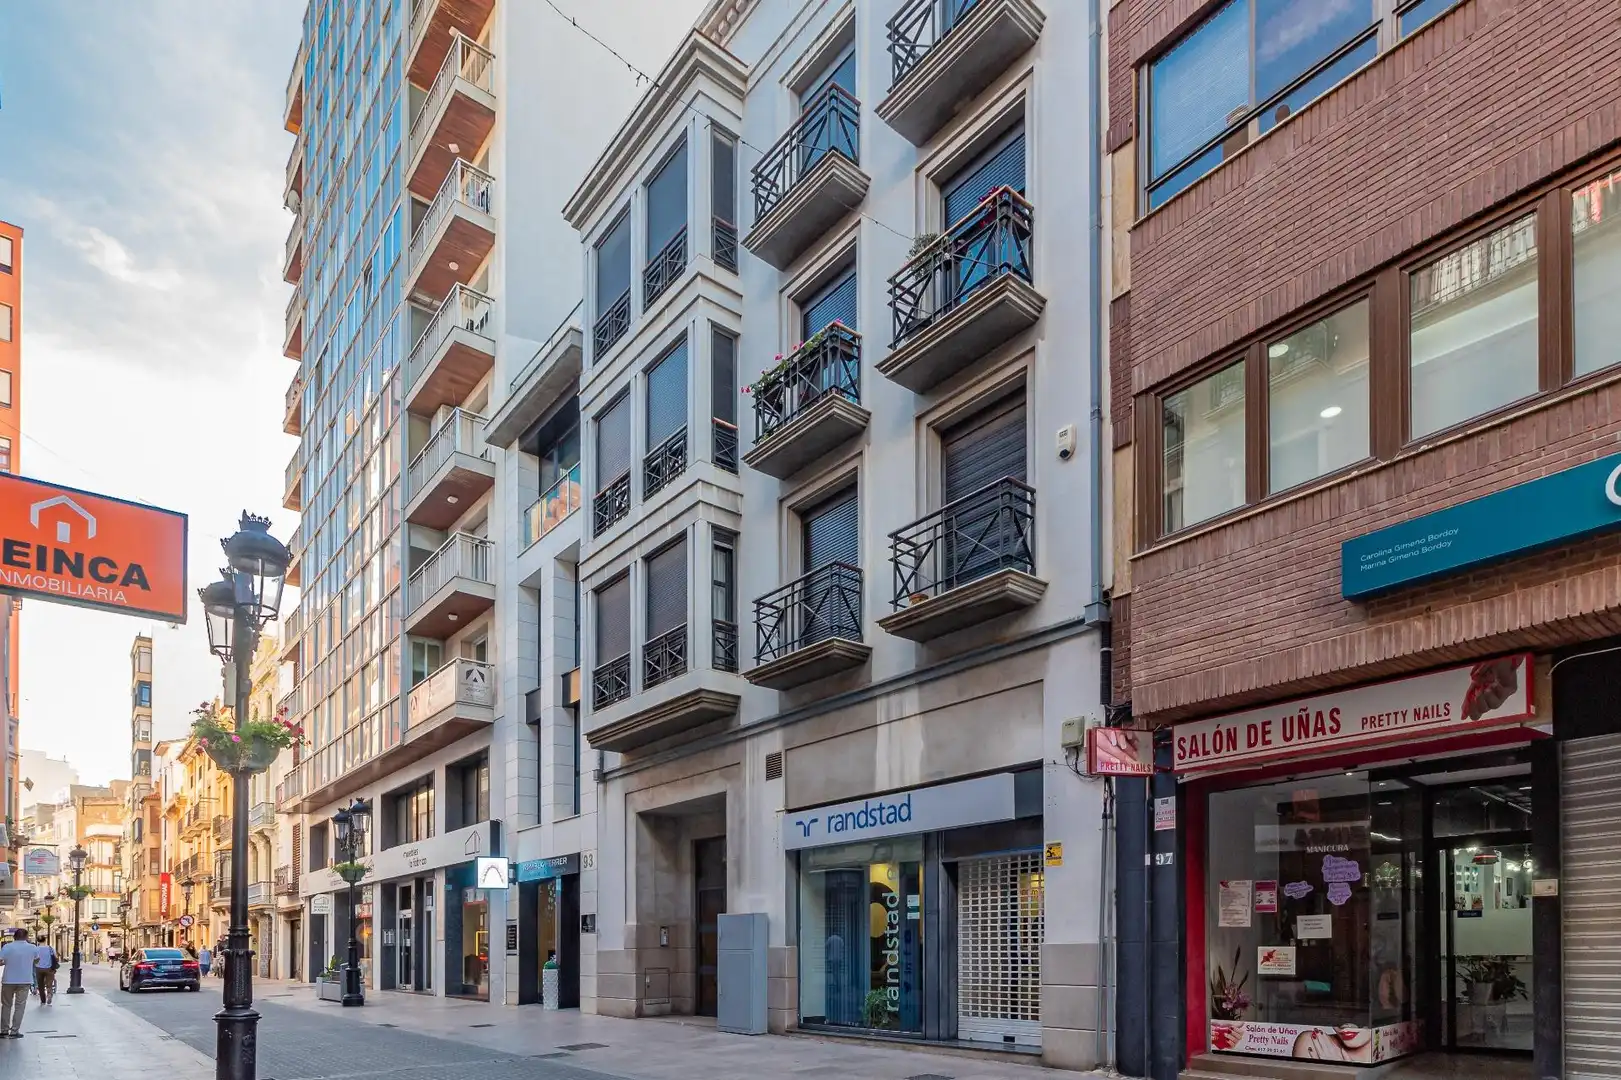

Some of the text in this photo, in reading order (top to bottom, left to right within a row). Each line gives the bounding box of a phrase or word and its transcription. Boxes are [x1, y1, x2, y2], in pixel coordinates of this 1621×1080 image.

[1360, 528, 1459, 562] Carolina Gimeno Bordoy
[1360, 540, 1453, 571] Marina Gimeno Bordoy
[3, 537, 151, 592] EINCA
[1177, 702, 1451, 761] SALÓN DE UÑAS PRETTY NAILS
[1100, 761, 1152, 773] PRETTY NAILS
[827, 793, 912, 834] randstad
[1155, 852, 1174, 865] 97
[1306, 843, 1349, 853] MANICURA
[583, 853, 594, 869] 93
[882, 891, 899, 1012] randstad
[1246, 1024, 1298, 1035] Salón de Uñas
[1248, 1034, 1289, 1046] Pretty Nails
